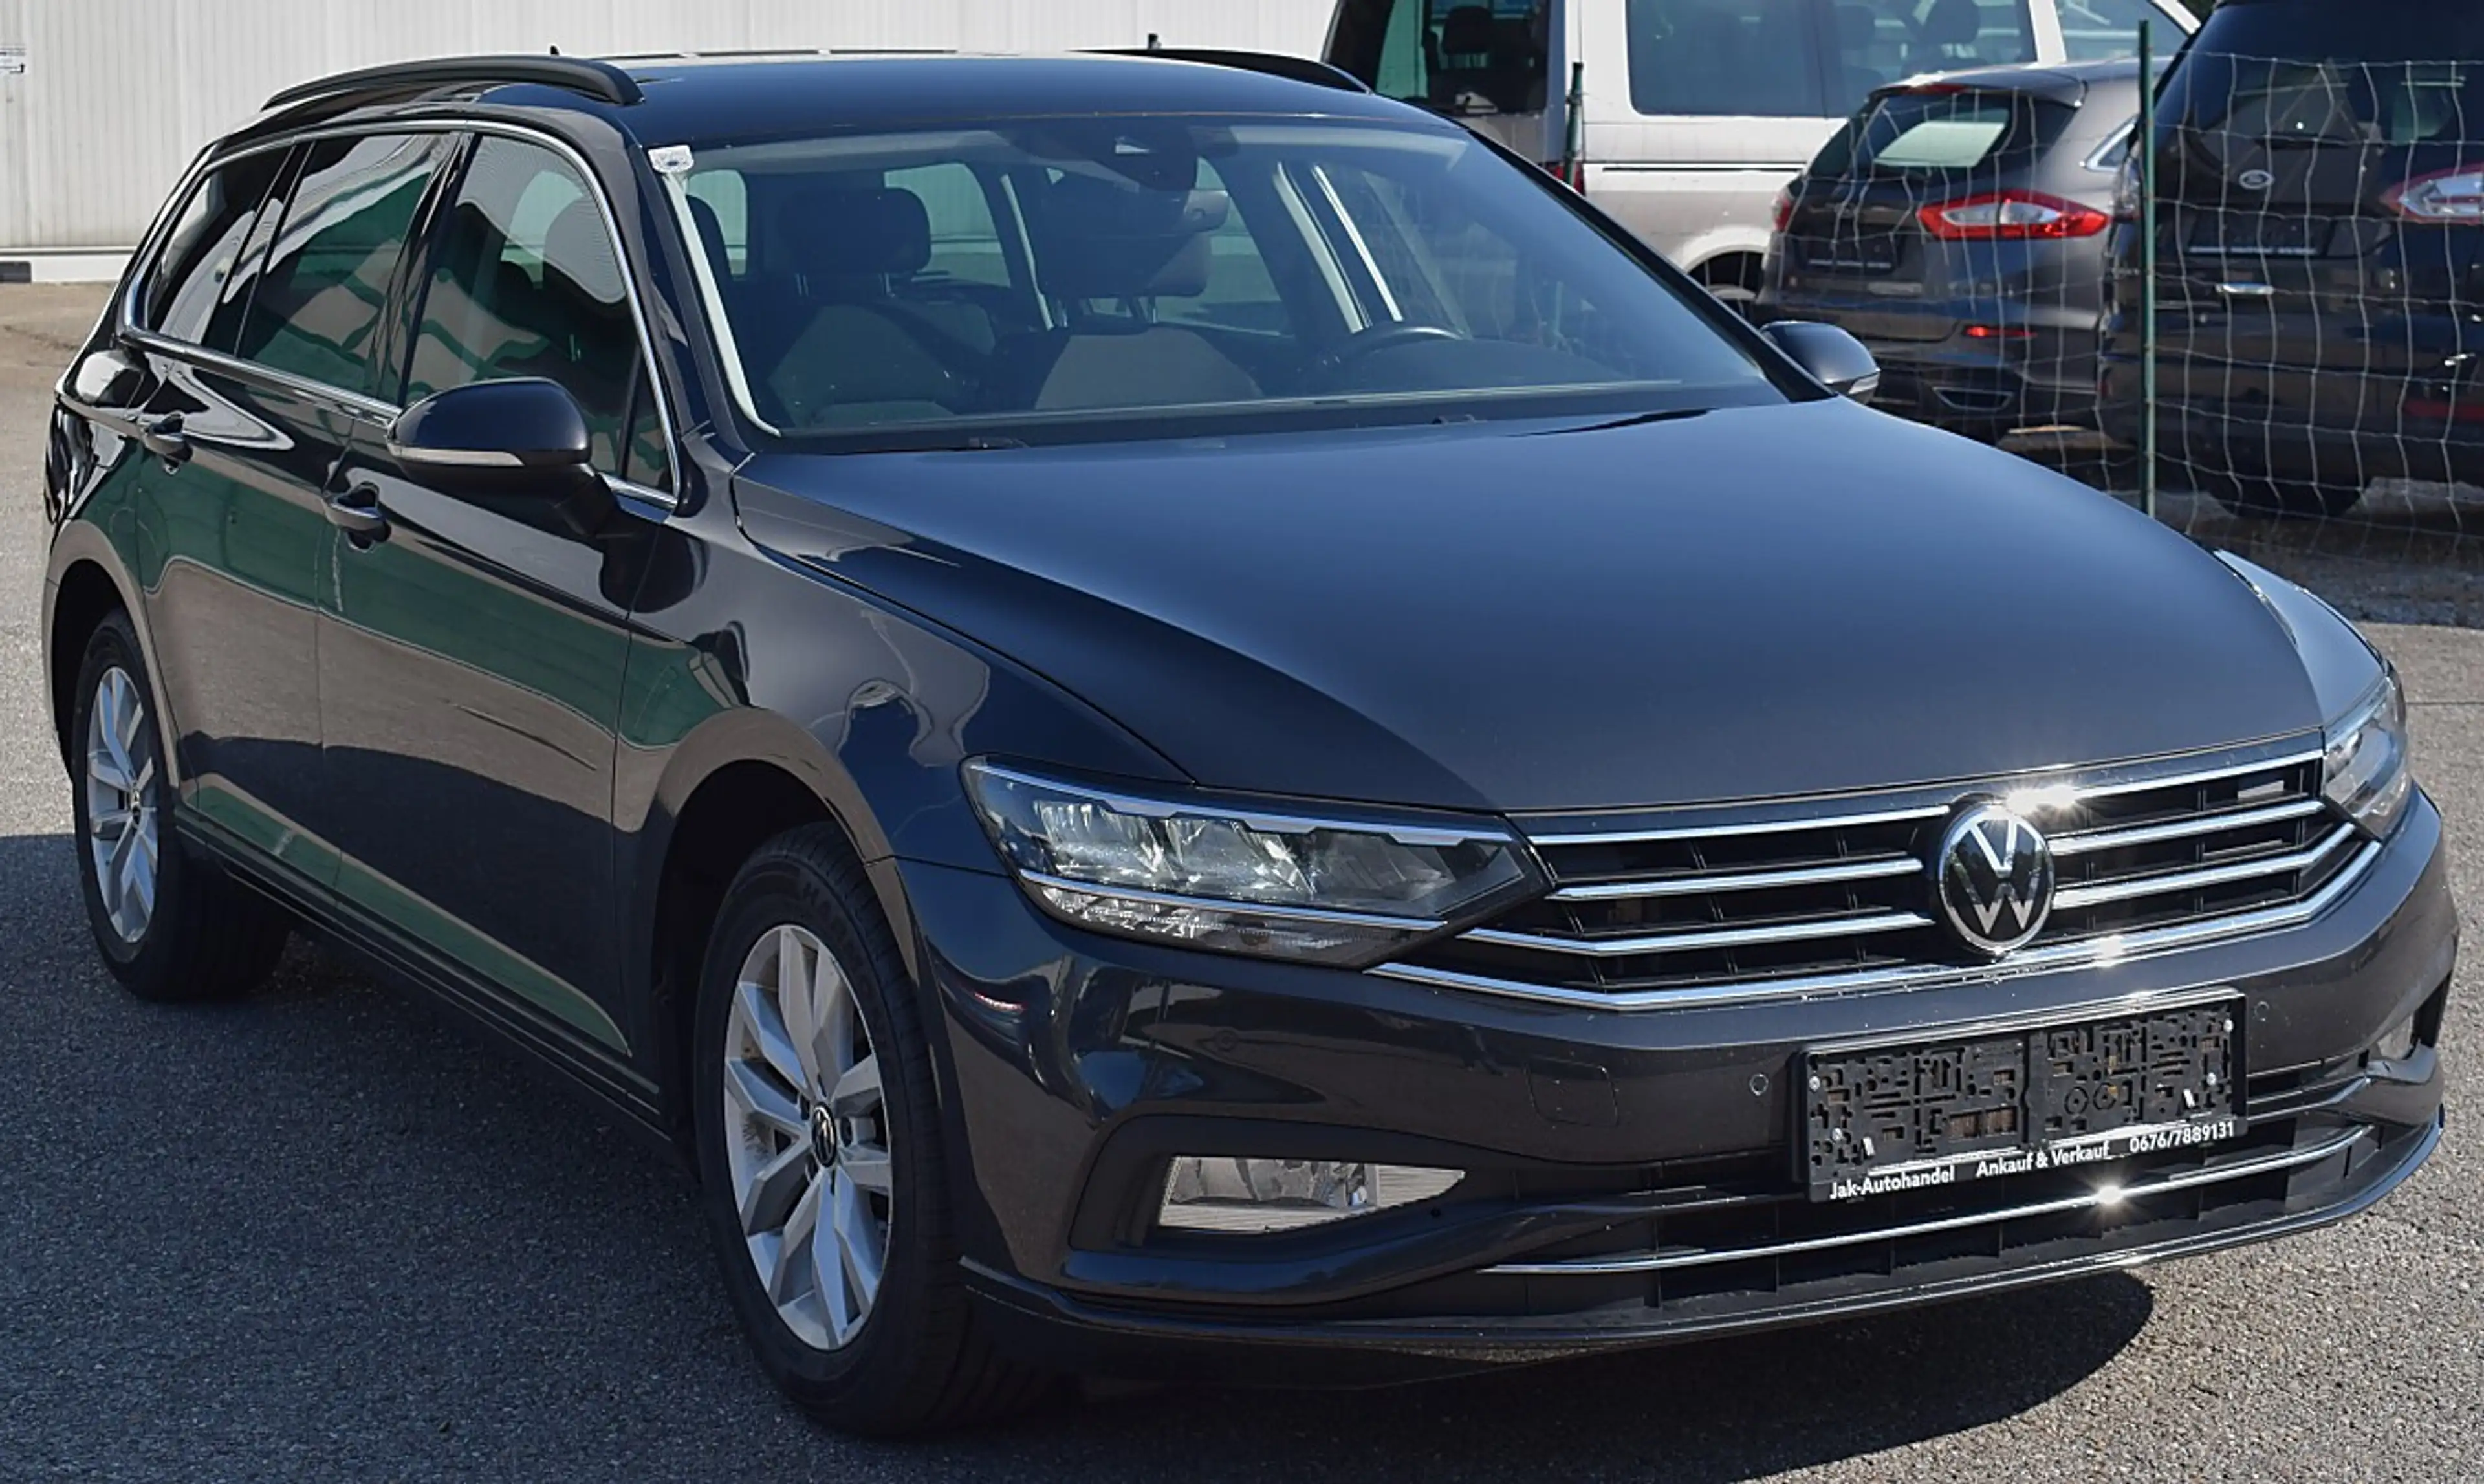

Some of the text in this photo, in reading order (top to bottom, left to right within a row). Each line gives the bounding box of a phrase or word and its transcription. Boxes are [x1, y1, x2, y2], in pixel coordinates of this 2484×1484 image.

[2129, 1121, 2235, 1153] 0676/7889131
[1975, 1140, 2110, 1178] Ankauf & Verkauf
[1829, 1164, 1956, 1199] Jak-Autohandel
